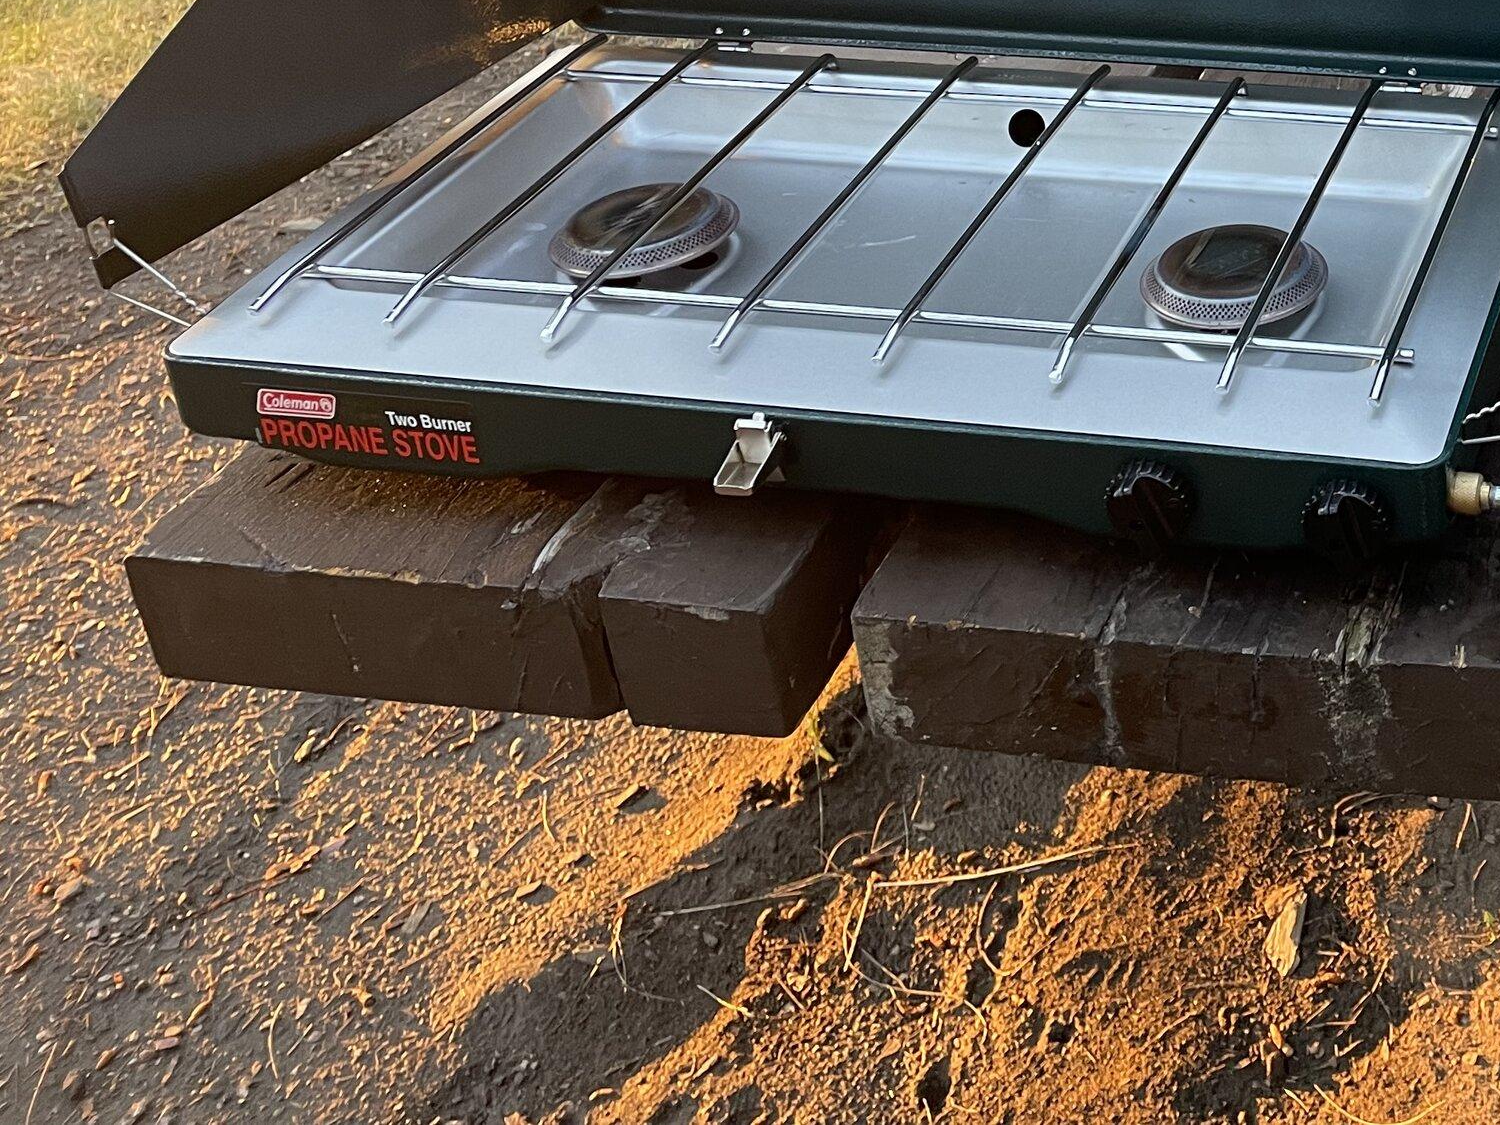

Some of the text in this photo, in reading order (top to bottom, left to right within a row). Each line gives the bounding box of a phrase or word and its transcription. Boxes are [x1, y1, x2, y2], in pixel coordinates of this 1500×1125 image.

[262, 392, 319, 411] Coleman
[385, 411, 471, 432] Two Burner
[260, 418, 480, 464] PROPANE STOVE
